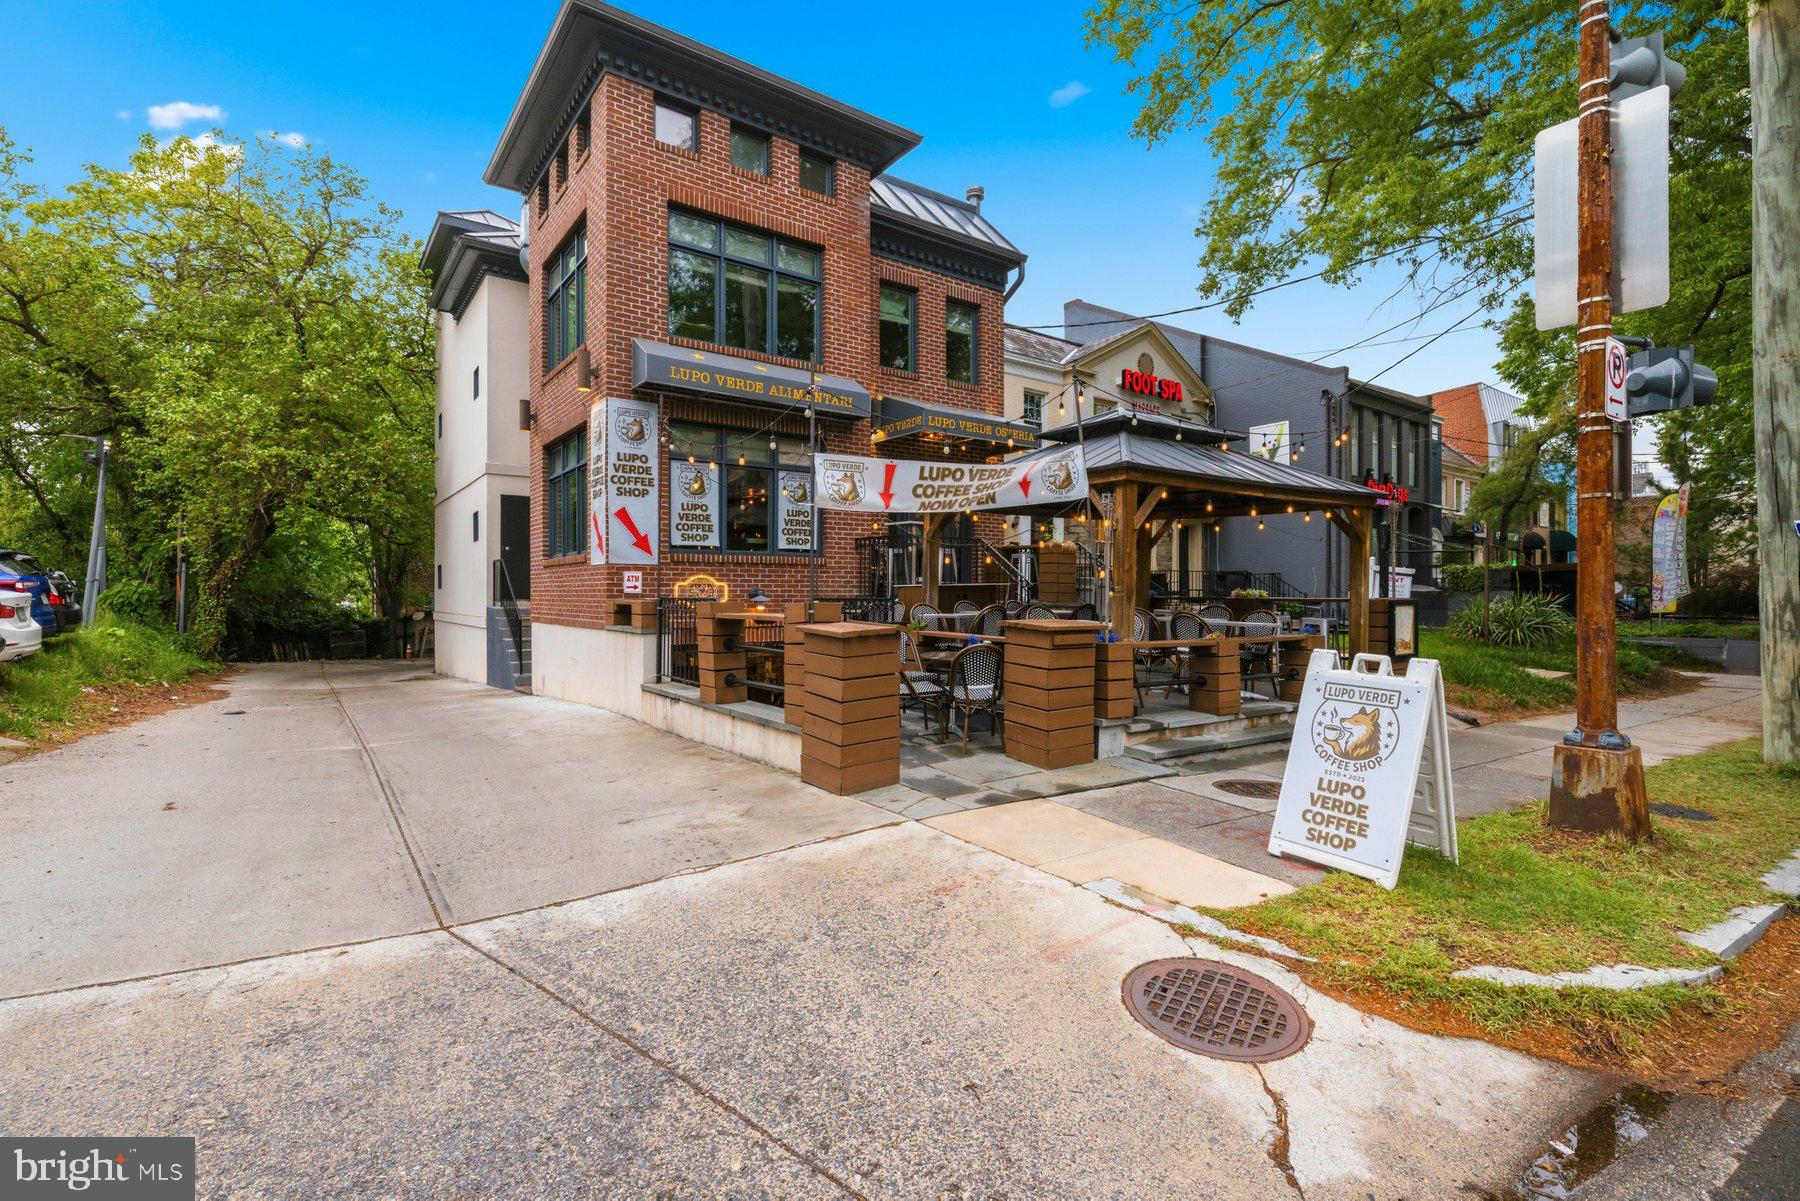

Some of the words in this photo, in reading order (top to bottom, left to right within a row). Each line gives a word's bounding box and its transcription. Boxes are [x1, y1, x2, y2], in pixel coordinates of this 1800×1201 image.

[670, 366, 711, 384] LUPO
[715, 374, 764, 393] VERDE
[1122, 369, 1158, 398] FOOT
[1158, 378, 1183, 402] SPA
[896, 415, 922, 431] VERDE
[928, 415, 956, 430] LUPO
[959, 421, 992, 435] VERDE
[995, 426, 1035, 442] OSTERIA
[617, 452, 648, 464] LUPO
[613, 463, 652, 475] VERDE
[826, 461, 841, 469] LUPO
[842, 463, 862, 471] VERDE
[919, 465, 965, 482] LUPO
[968, 467, 1016, 481] VERDE
[610, 475, 655, 487] COFFEE
[616, 487, 649, 498] SHOP
[912, 483, 973, 498] COFFEE
[973, 479, 1010, 495] SHOP
[681, 503, 708, 512] LUPO
[917, 498, 958, 511] NOW
[958, 491, 996, 508] OPEN
[678, 513, 712, 523] VERDE
[786, 509, 810, 518] LUPO
[676, 523, 714, 533] COFFEE
[784, 518, 812, 527] VERDE
[681, 533, 709, 542] SHOP
[786, 537, 810, 546] SHOP
[626, 574, 640, 583] ATM
[1328, 686, 1355, 700] LUPO
[1359, 689, 1396, 705] VERDE
[1315, 744, 1351, 771] COFFEE
[1353, 756, 1384, 773] SHOP
[1317, 777, 1366, 800] LUPO
[1309, 792, 1369, 820] VERDE
[1301, 809, 1369, 839] COFFEE
[1305, 827, 1357, 852] SHOP
